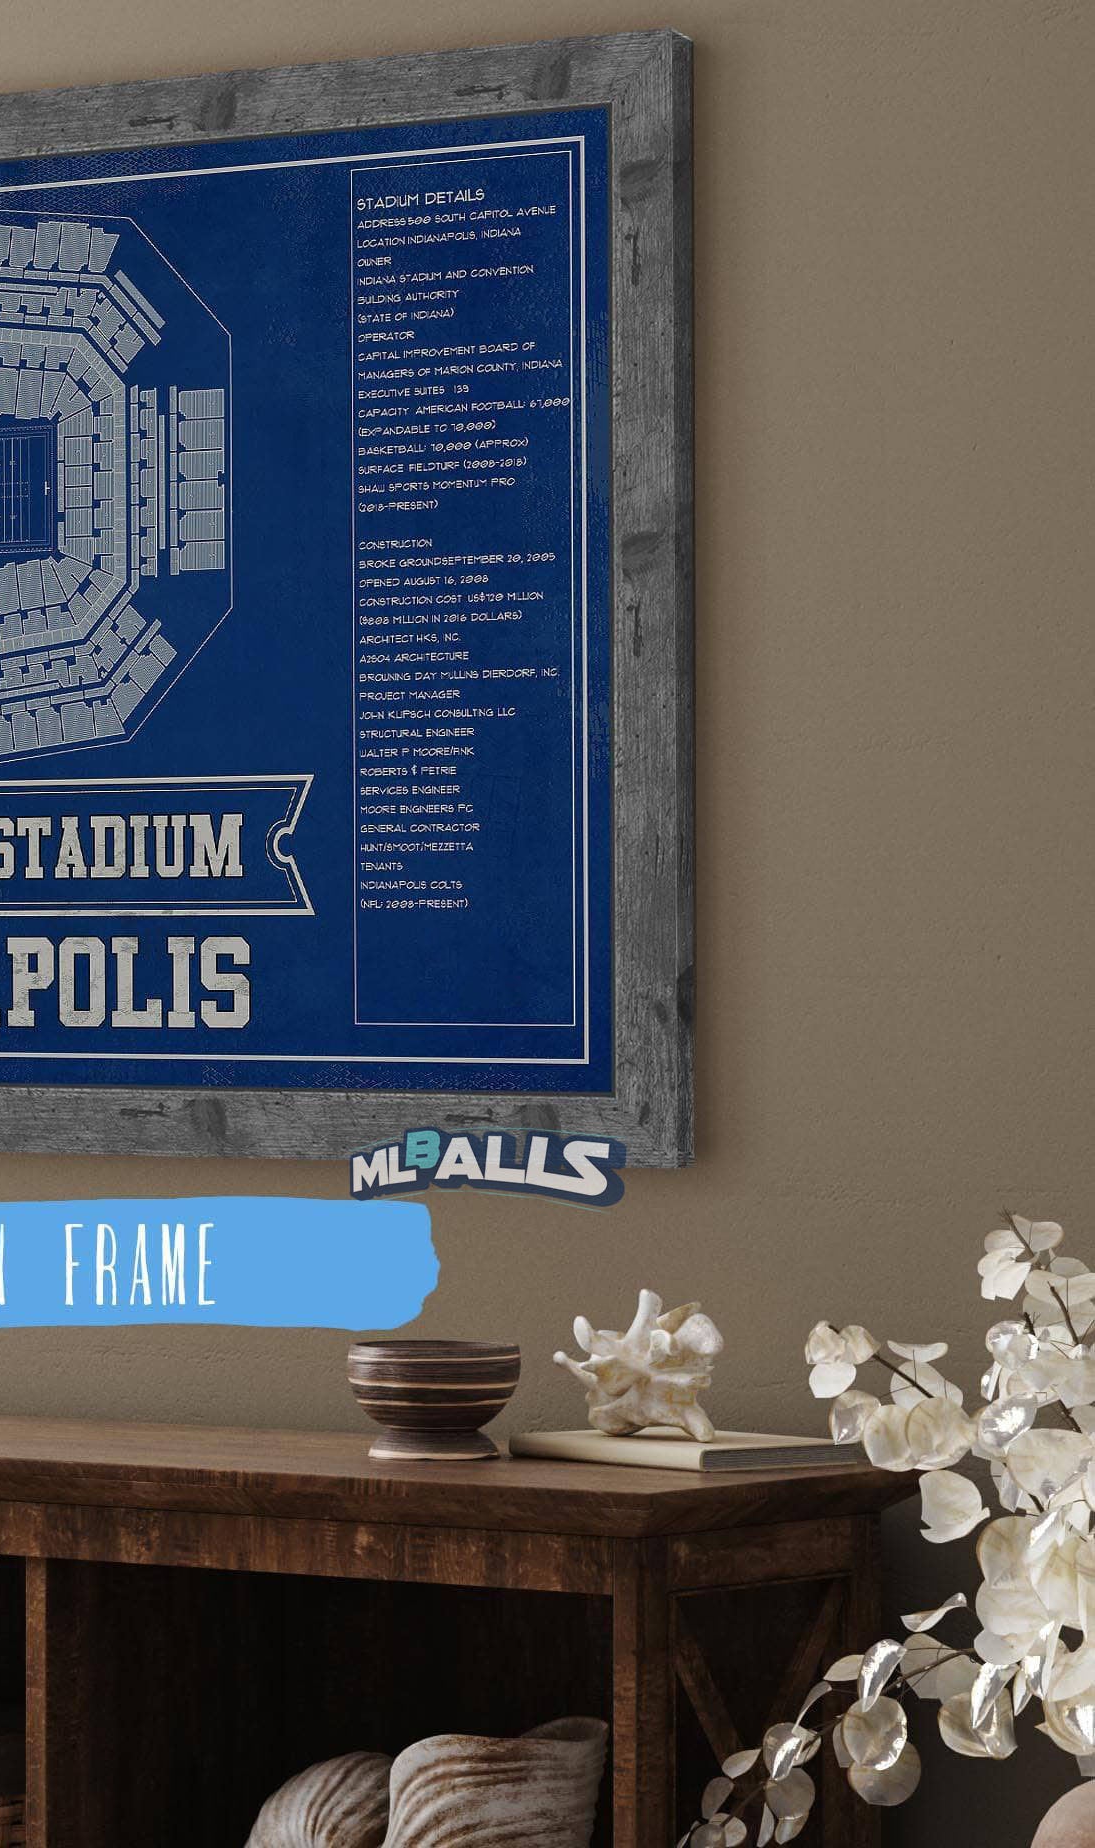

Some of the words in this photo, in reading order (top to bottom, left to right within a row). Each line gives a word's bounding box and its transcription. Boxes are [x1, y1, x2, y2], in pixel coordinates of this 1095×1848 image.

[357, 194, 418, 210] STADIUM
[425, 189, 484, 204] DETAILS
[435, 213, 465, 223] SOUTH
[470, 210, 512, 220] CAPITOL
[517, 206, 556, 216] AVENUE
[358, 237, 405, 248] LOCATION
[482, 228, 520, 238] INDIANA
[358, 257, 391, 267] OWNER
[357, 275, 396, 286] INDIANA
[400, 272, 441, 283] STADIUM
[446, 270, 466, 278] AND
[471, 265, 533, 277] CONVENTION
[358, 294, 401, 304] BUILDING
[406, 290, 459, 300] AUTHORITY
[358, 314, 391, 323] (STATE
[395, 313, 407, 321] OF
[411, 309, 454, 320] INDIANA)
[359, 331, 414, 342] OPERATOR
[359, 351, 400, 361] CAPITAL
[404, 346, 475, 358] IMPROVEMENT
[480, 343, 518, 353] BOARD
[522, 342, 535, 350] OF
[358, 369, 414, 379] MANAGERS
[418, 368, 430, 376] OF
[435, 365, 473, 375] MARION
[522, 360, 562, 369] INDIANA
[359, 388, 410, 399] EXECUTIVE
[415, 386, 444, 395] SUITES
[359, 408, 409, 417] CAPACITY
[416, 404, 467, 414] AMERICAN
[359, 425, 430, 436] (EXPANDABLE
[434, 424, 447, 432] TO
[359, 464, 403, 474] SURFACE
[409, 462, 459, 471] FIELDTURF
[359, 485, 384, 493] SHAW
[389, 482, 429, 491] SPORTS
[433, 480, 486, 489] MOMENTUM
[360, 539, 432, 549] CONSTRUCTION
[359, 559, 395, 568] BROKE
[527, 553, 555, 561] 2005
[360, 578, 400, 587] OPENED
[404, 577, 440, 585] AUGUST
[445, 576, 456, 585] 16,
[461, 575, 488, 583] 2008
[360, 596, 432, 606] CONSTRUCTION
[436, 595, 461, 603] COST
[508, 592, 543, 600] MILLION
[393, 615, 428, 624] MILLION
[432, 614, 440, 622] IN
[444, 614, 466, 622] 2016
[471, 610, 522, 621] DOLLARS)
[360, 635, 413, 644] ARCHITECT
[394, 652, 469, 662] ARCHITECTURE
[360, 673, 410, 682] BROWNING
[415, 672, 436, 680] DAY
[360, 692, 405, 700] PROJECT
[410, 690, 460, 699] MANAGER
[360, 711, 384, 719] JOHN
[498, 708, 515, 716] LLC
[360, 729, 422, 738] STRUCTURAL
[426, 728, 474, 737] ENGINEER
[361, 749, 397, 757] WALTER
[361, 768, 407, 776] ROBERTS
[361, 786, 408, 795] SERVICES
[412, 785, 460, 794] ENGINEER
[361, 806, 396, 814] MOORE
[400, 805, 454, 813] ENGINEERS
[458, 804, 473, 812] PC
[361, 824, 406, 832] GENERAL
[410, 823, 479, 832] CONTRACTOR
[361, 862, 403, 870] TENANTS
[361, 881, 426, 889] INDIANAPOLIS
[431, 881, 462, 889] COLTS
